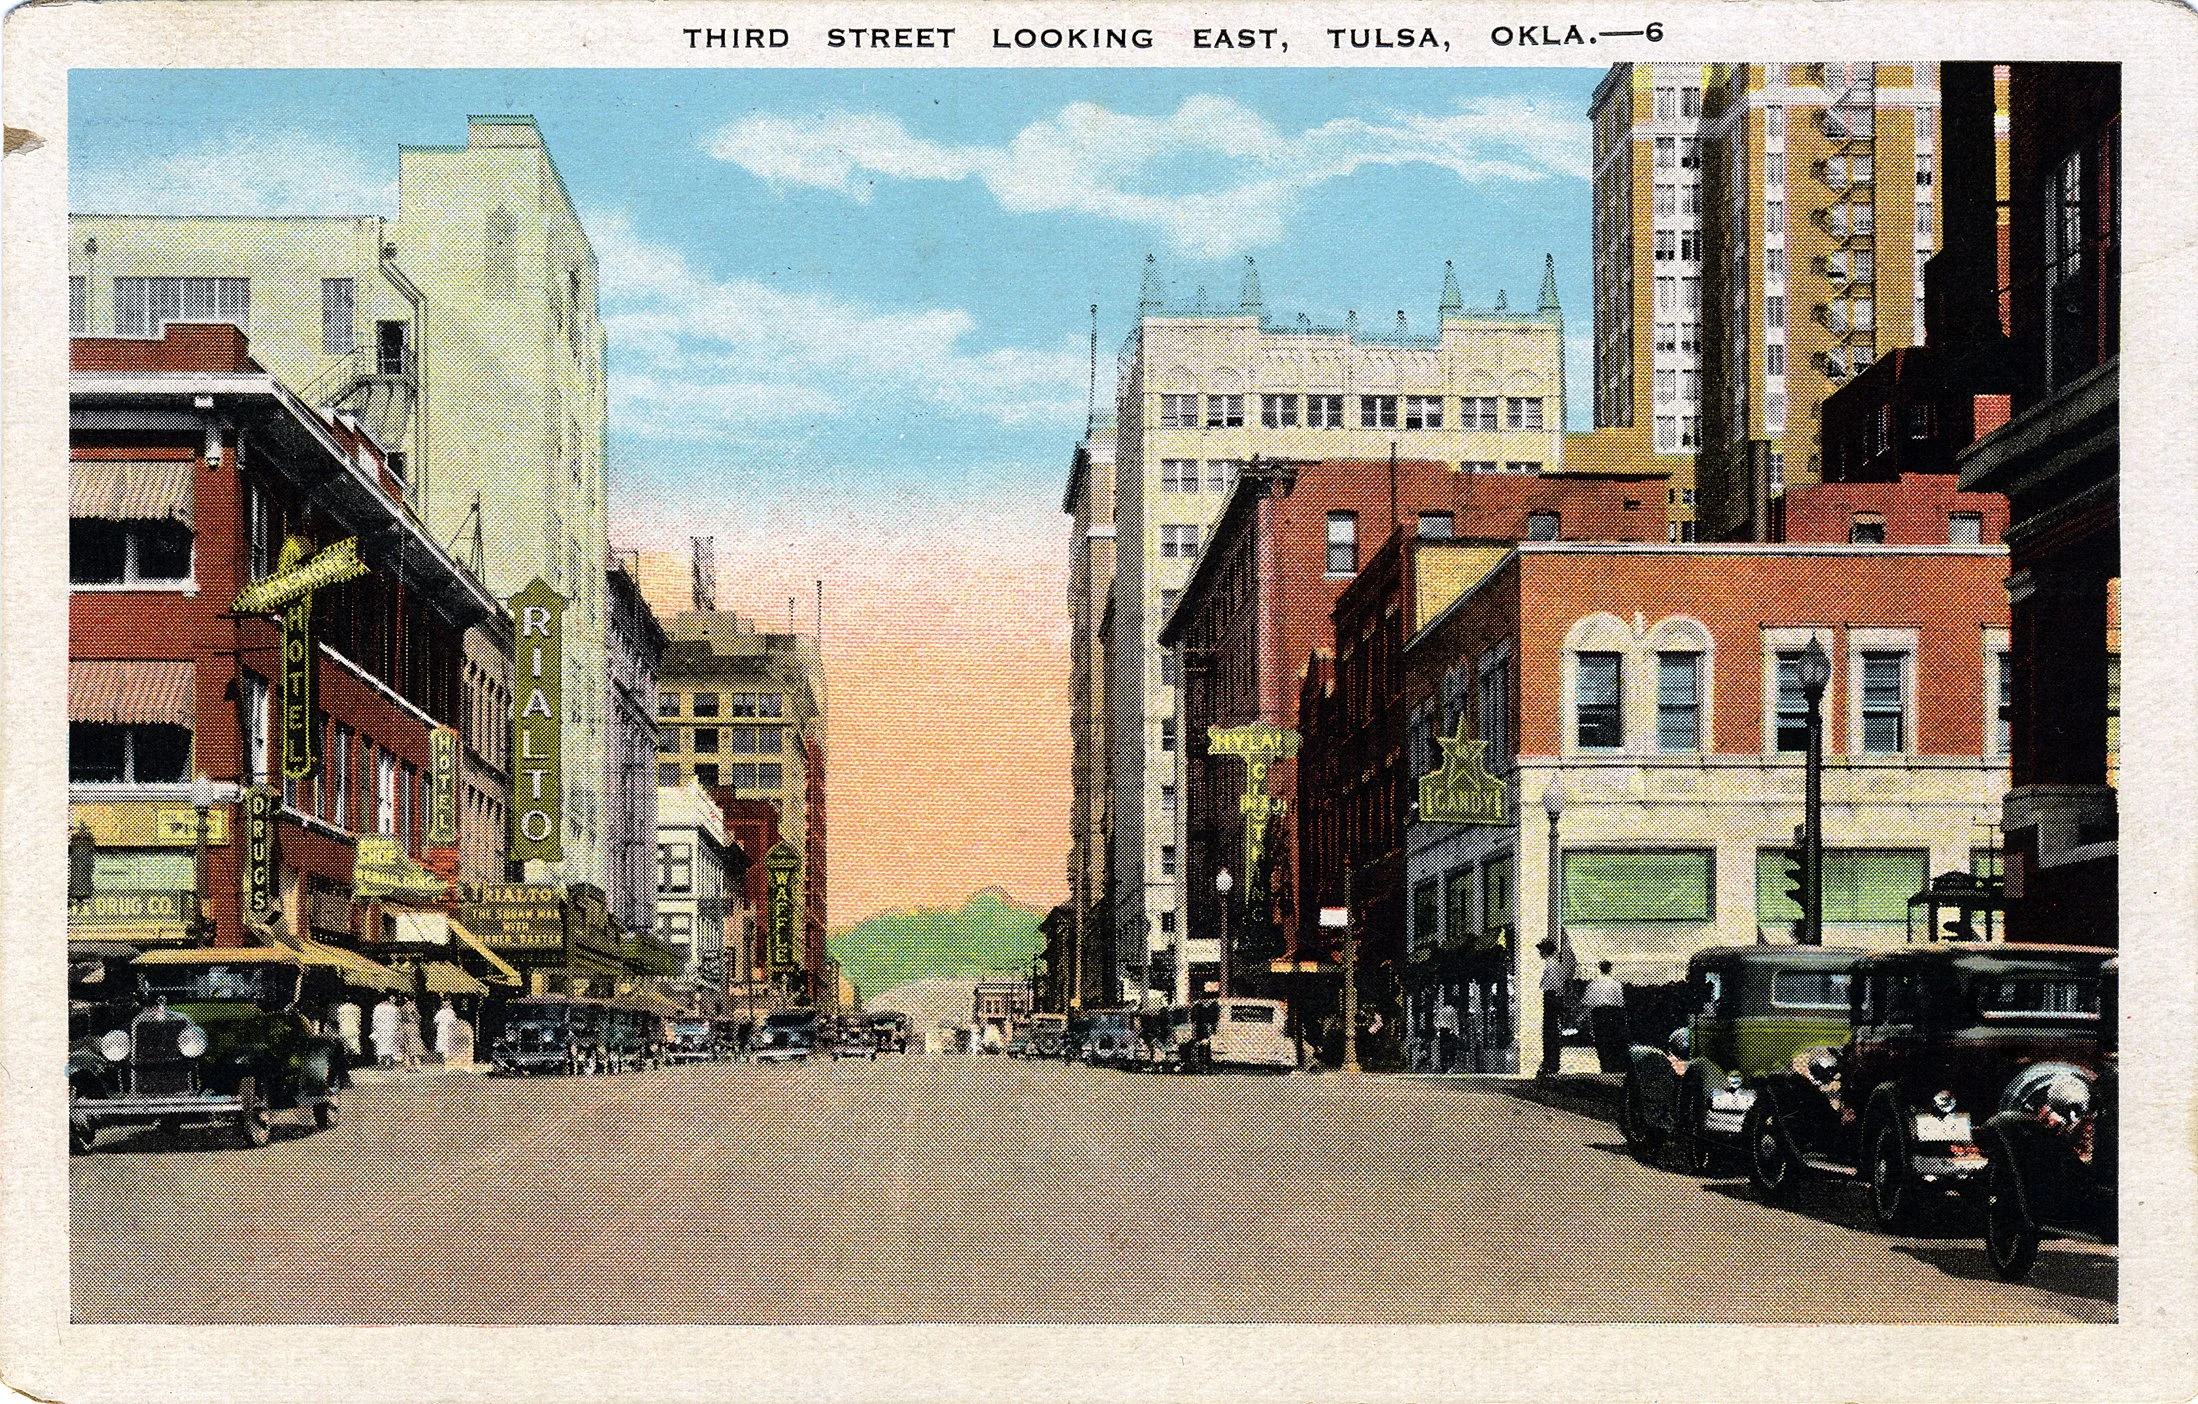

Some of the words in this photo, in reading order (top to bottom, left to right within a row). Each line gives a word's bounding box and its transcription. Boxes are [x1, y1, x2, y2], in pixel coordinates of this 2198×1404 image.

[256, 552, 349, 604] DENSMORE
[287, 606, 303, 762] HOTEL
[520, 604, 553, 842] RIALTO
[438, 735, 451, 829] HOTEL
[1435, 789, 1494, 814] CANDY
[253, 794, 266, 910] DRUGS
[358, 851, 398, 865] SHOE
[355, 870, 436, 889] REBUILDING
[484, 886, 553, 903] RIALTO
[94, 895, 144, 916] DRUG
[775, 871, 789, 963] WAFFLE
[501, 922, 530, 932] WITH
